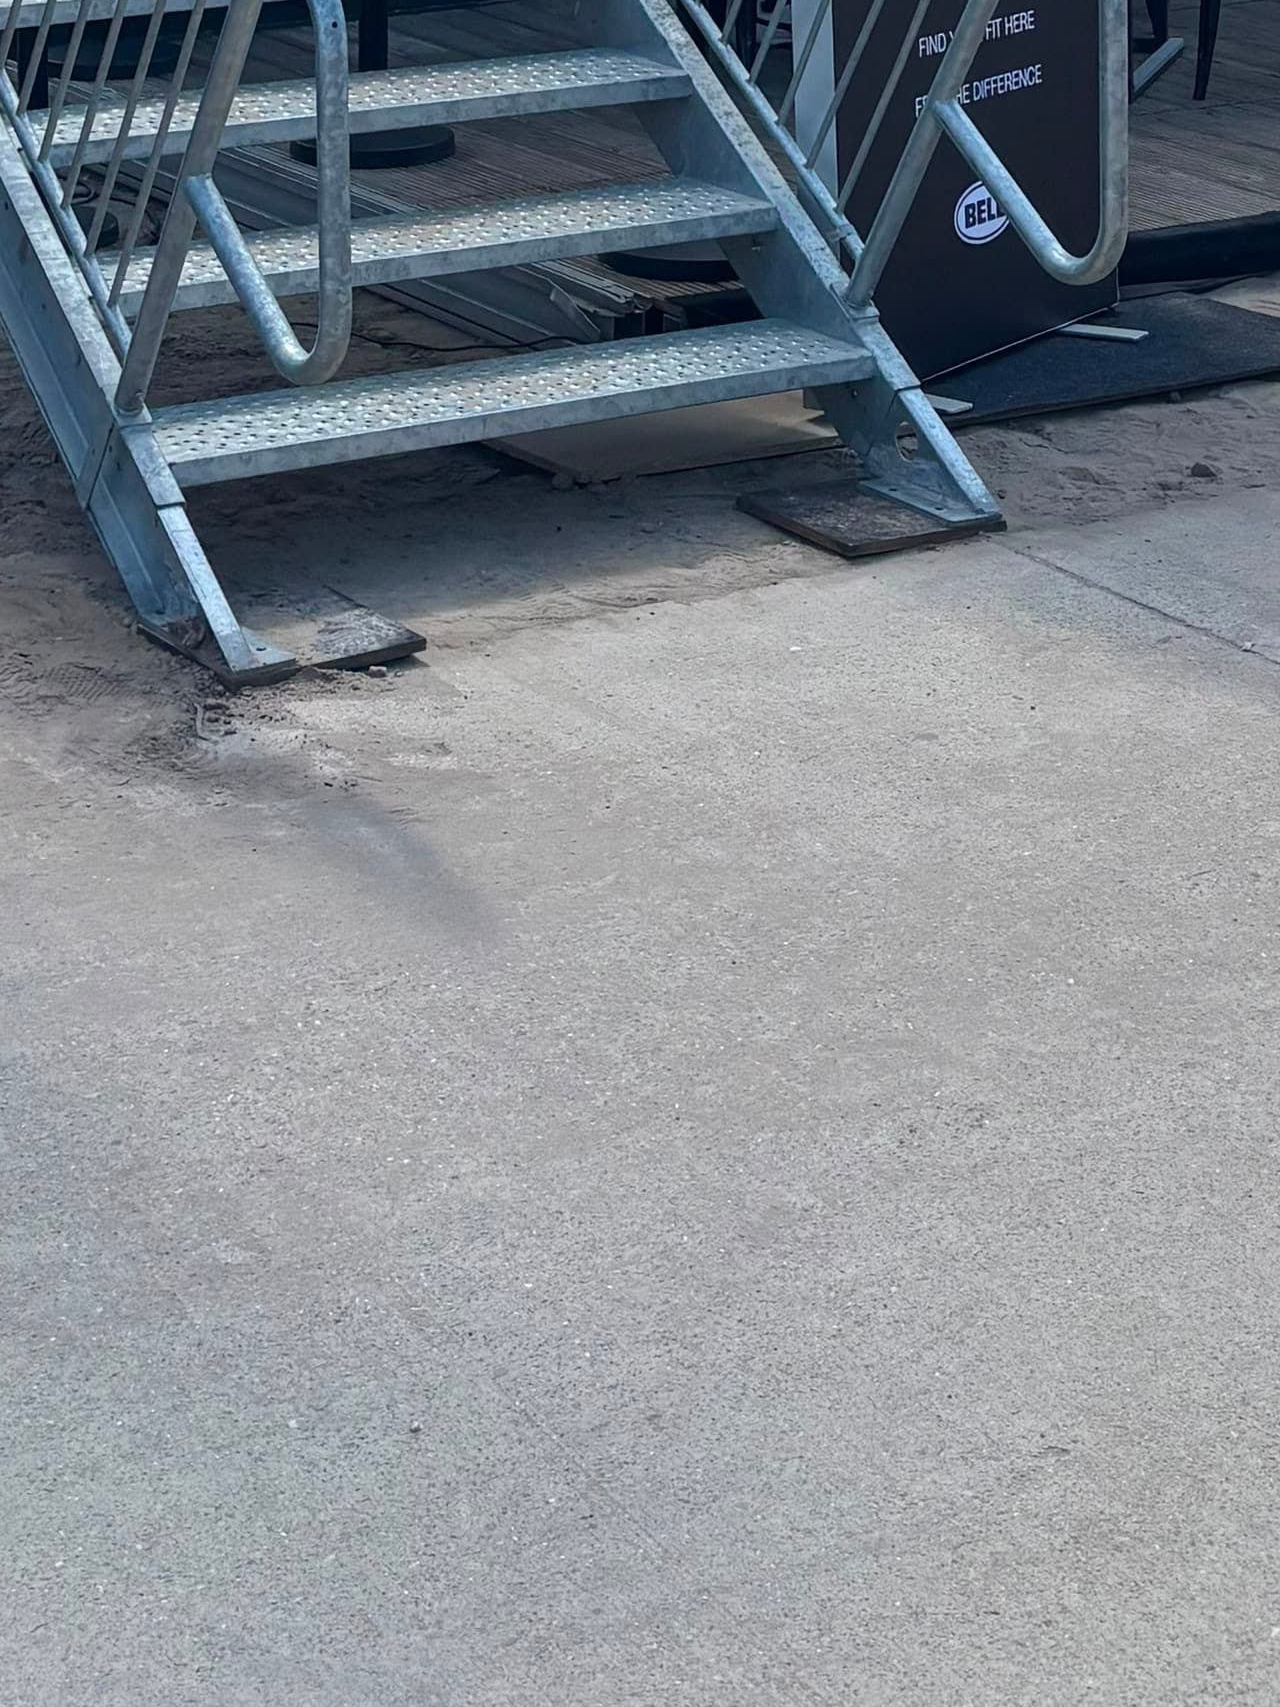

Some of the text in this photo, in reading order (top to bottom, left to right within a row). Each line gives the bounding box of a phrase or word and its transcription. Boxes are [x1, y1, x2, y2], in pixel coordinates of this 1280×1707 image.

[919, 33, 947, 58] FIND
[985, 17, 1003, 41] FIT
[1005, 10, 1036, 35] HERE
[973, 64, 1043, 101] DIFFERENCE
